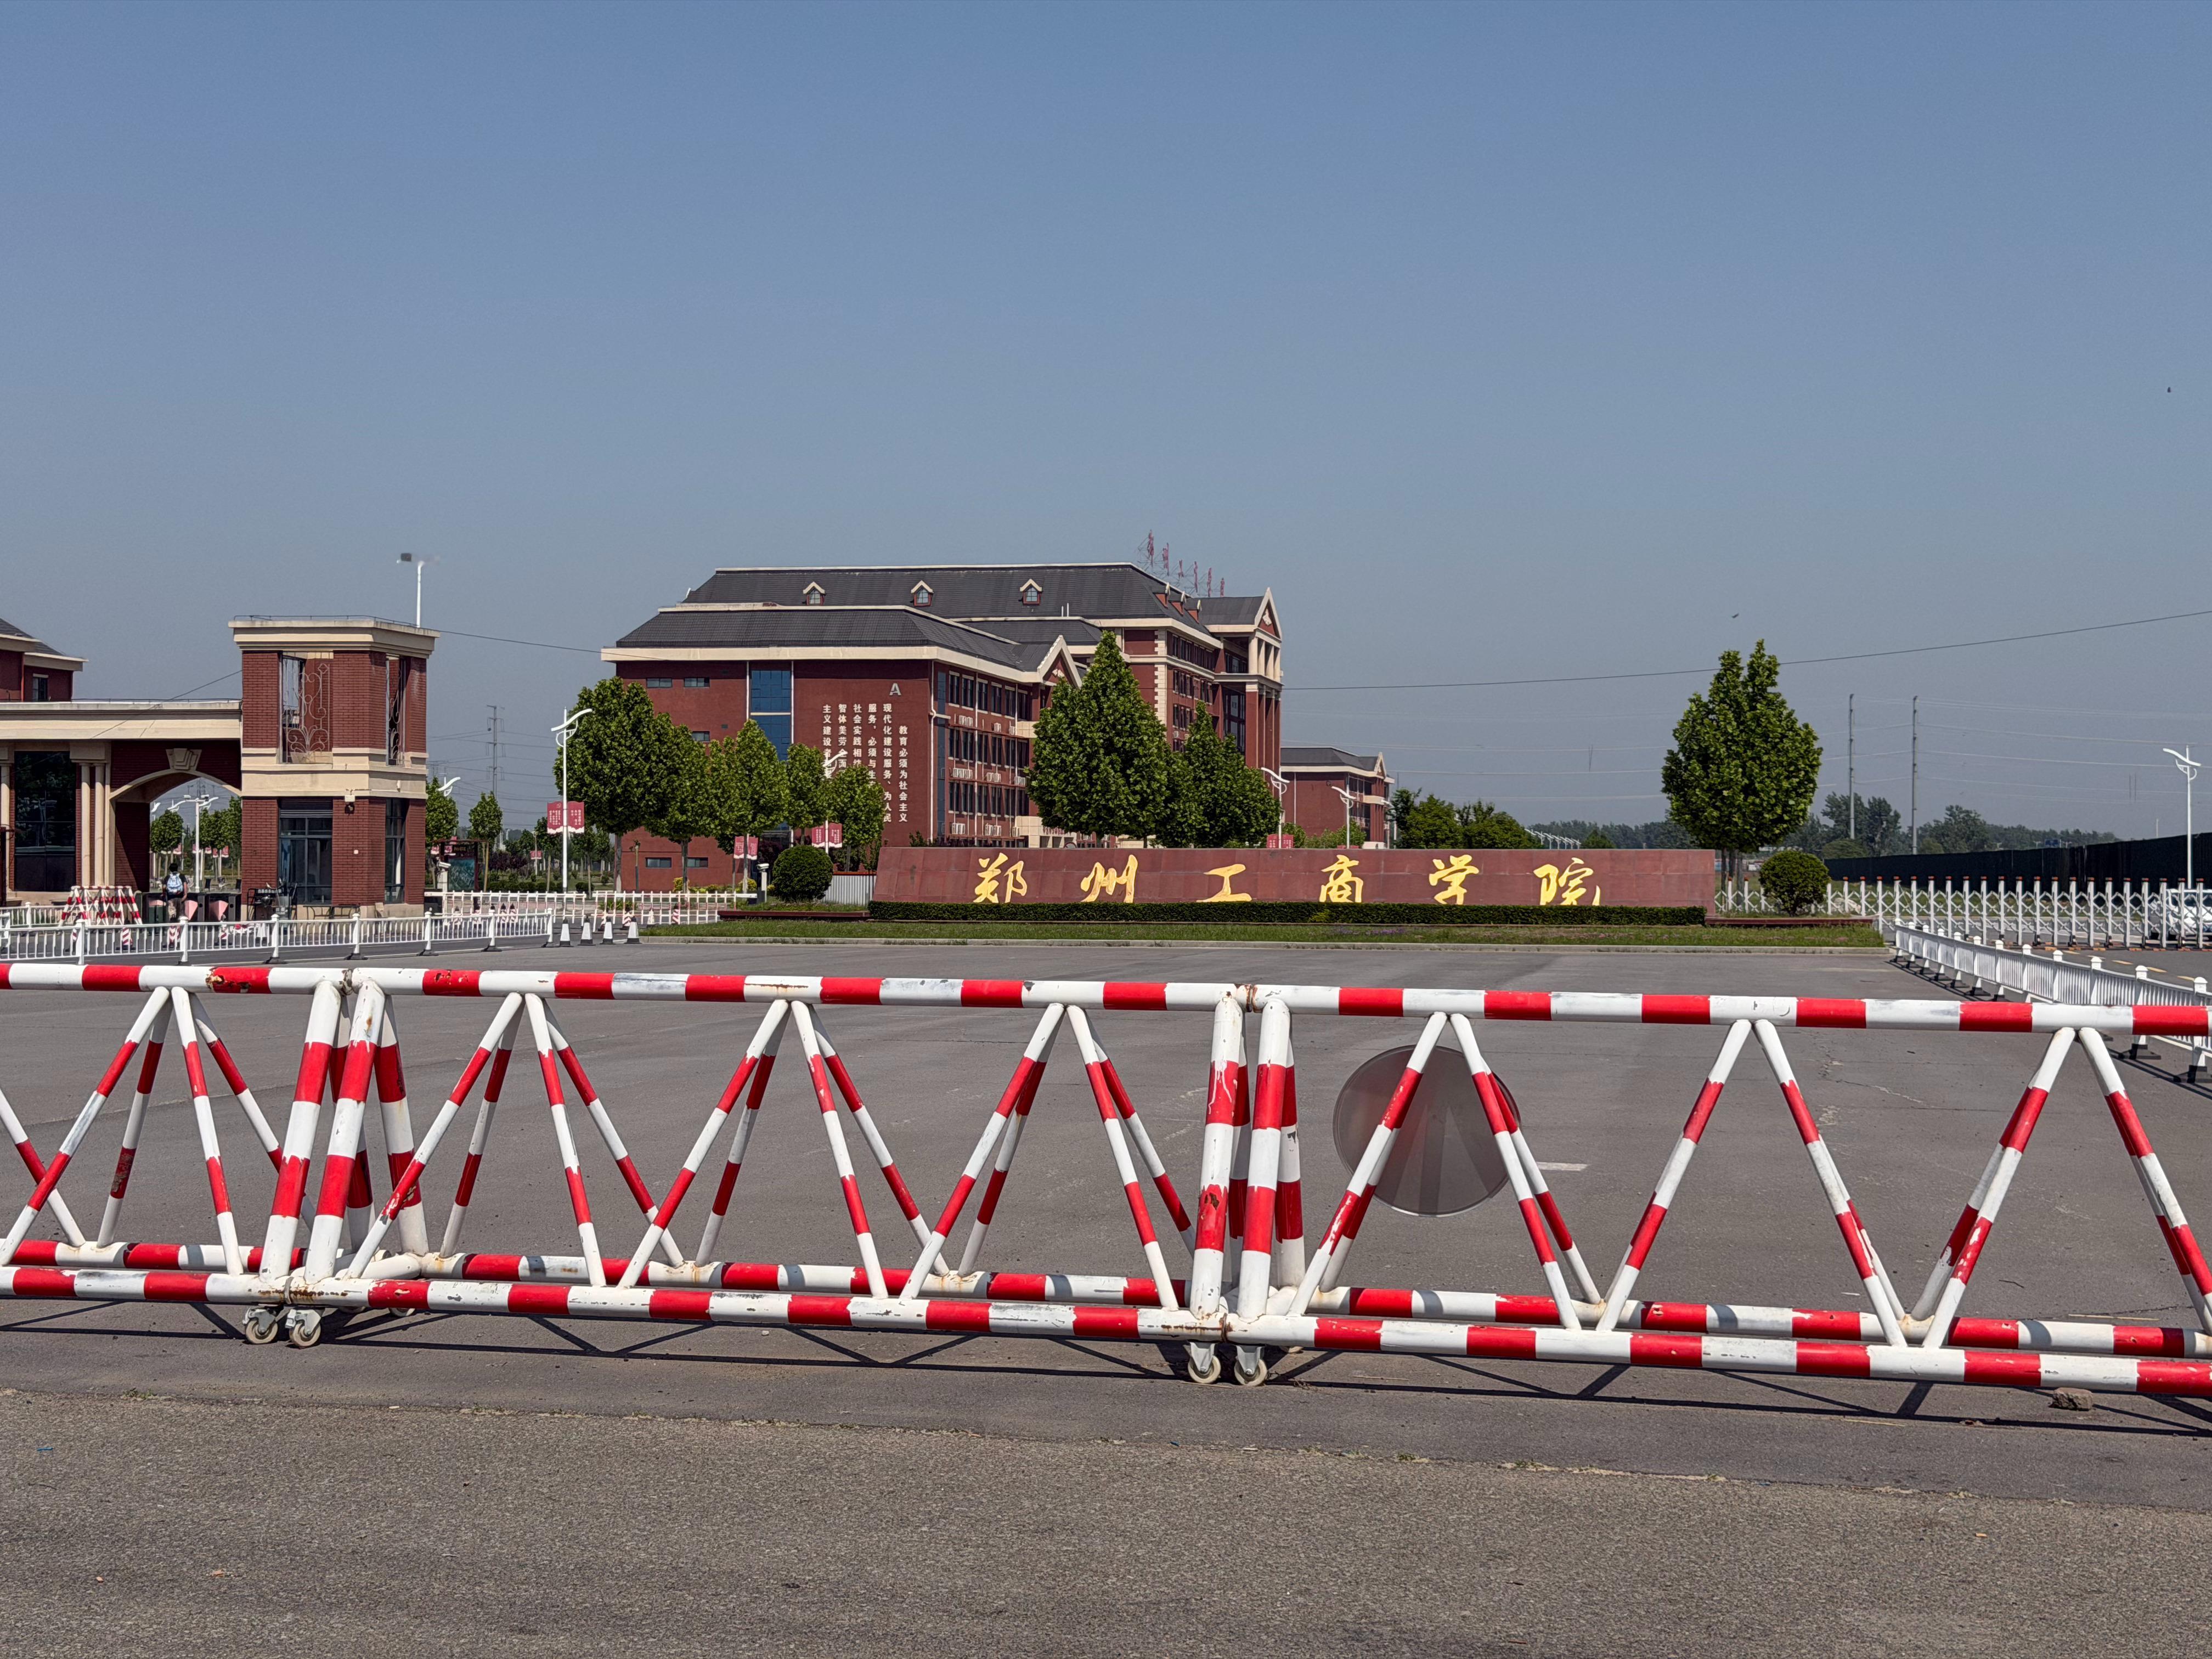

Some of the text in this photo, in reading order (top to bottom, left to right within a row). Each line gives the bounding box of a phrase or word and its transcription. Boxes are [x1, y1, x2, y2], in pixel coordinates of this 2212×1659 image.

[889, 682, 901, 696] A
[838, 703, 847, 773] 智体美劳全面
[883, 703, 892, 822] 现代化建设服务、为人民
[899, 725, 908, 822] 教育必须为社会主义
[973, 853, 1601, 906] 郑州工商学院
